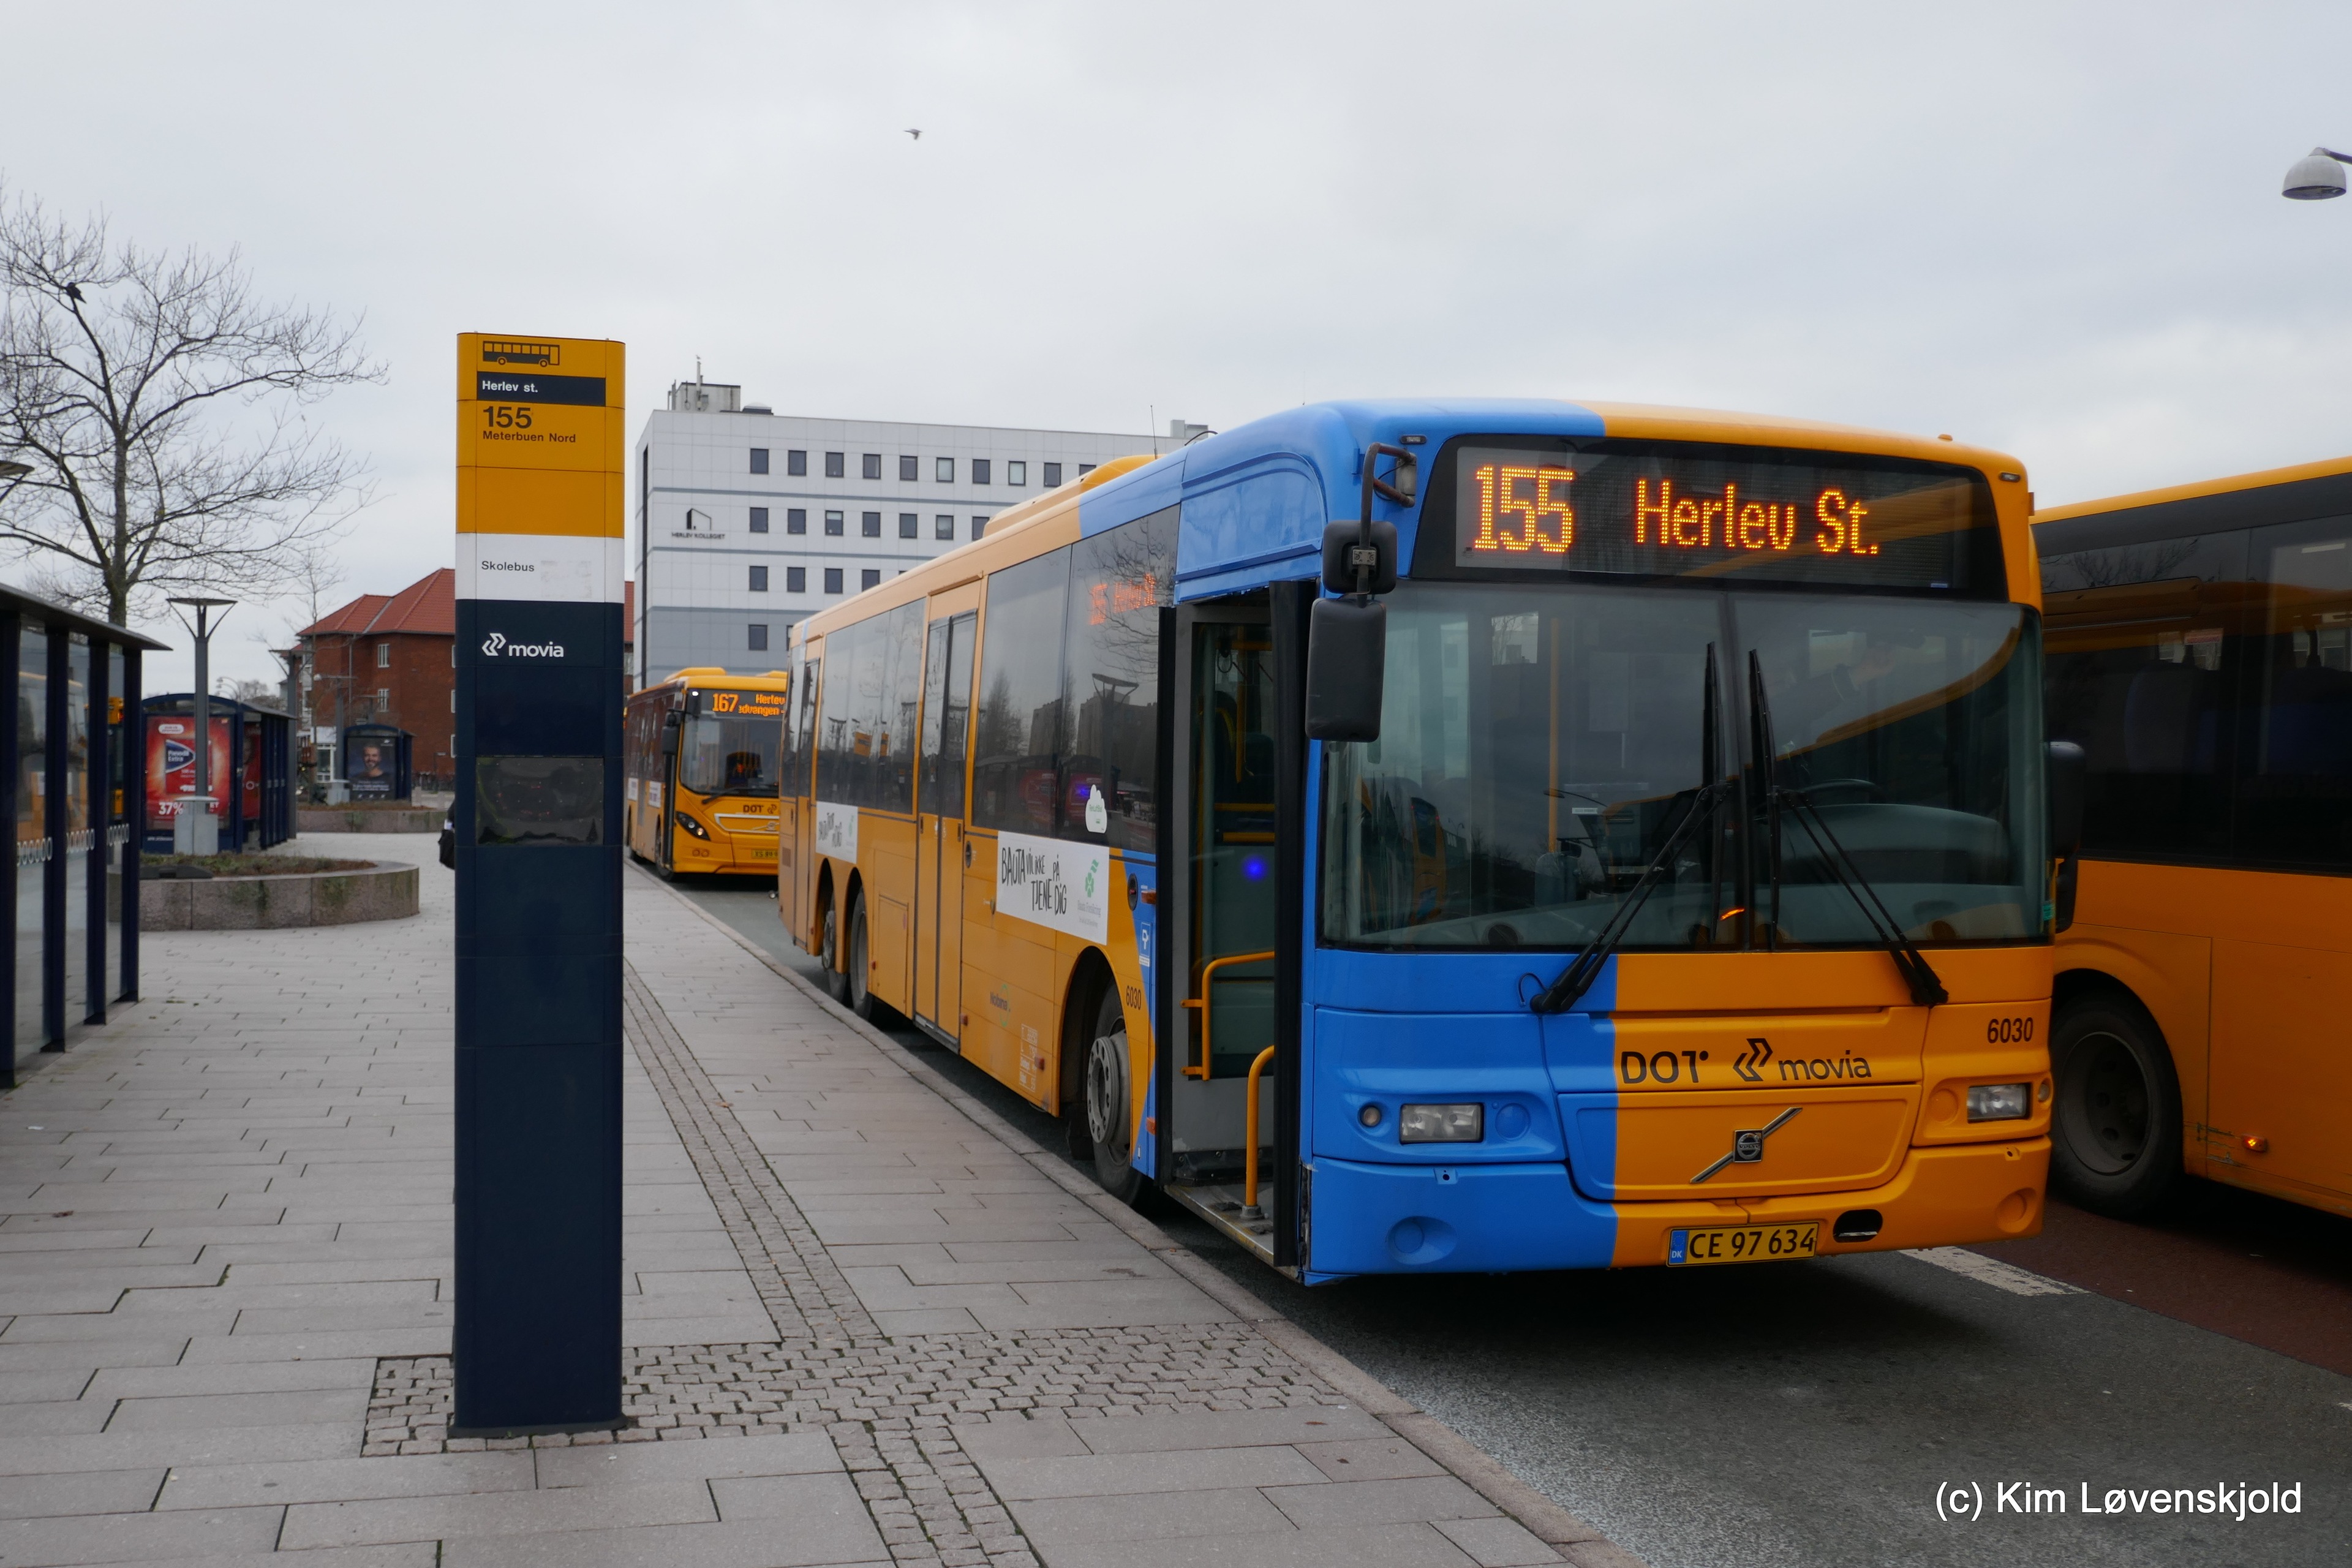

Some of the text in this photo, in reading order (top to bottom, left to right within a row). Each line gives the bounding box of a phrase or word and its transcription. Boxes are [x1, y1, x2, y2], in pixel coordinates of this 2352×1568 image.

[482, 380, 538, 393] Herlev st.
[483, 406, 532, 429] 155
[483, 431, 576, 443] Meterbuen Nord
[1474, 464, 1880, 556] 155 Herlev St.
[481, 560, 535, 571] Skolebus
[508, 641, 564, 657] movia
[712, 693, 739, 712] 167
[159, 802, 184, 815] 37%
[743, 805, 763, 813] DOT
[1001, 847, 1026, 886] BAUTA
[1053, 854, 1060, 881] PÅ
[1031, 878, 1052, 911] TJENE
[1126, 985, 1142, 1010] 6030
[1987, 1017, 2034, 1043] 6030
[1621, 1049, 1872, 1084] DOT movia
[1689, 1233, 1723, 1258] CE
[1731, 1231, 1763, 1257] 97
[1768, 1227, 1815, 1255] 634
